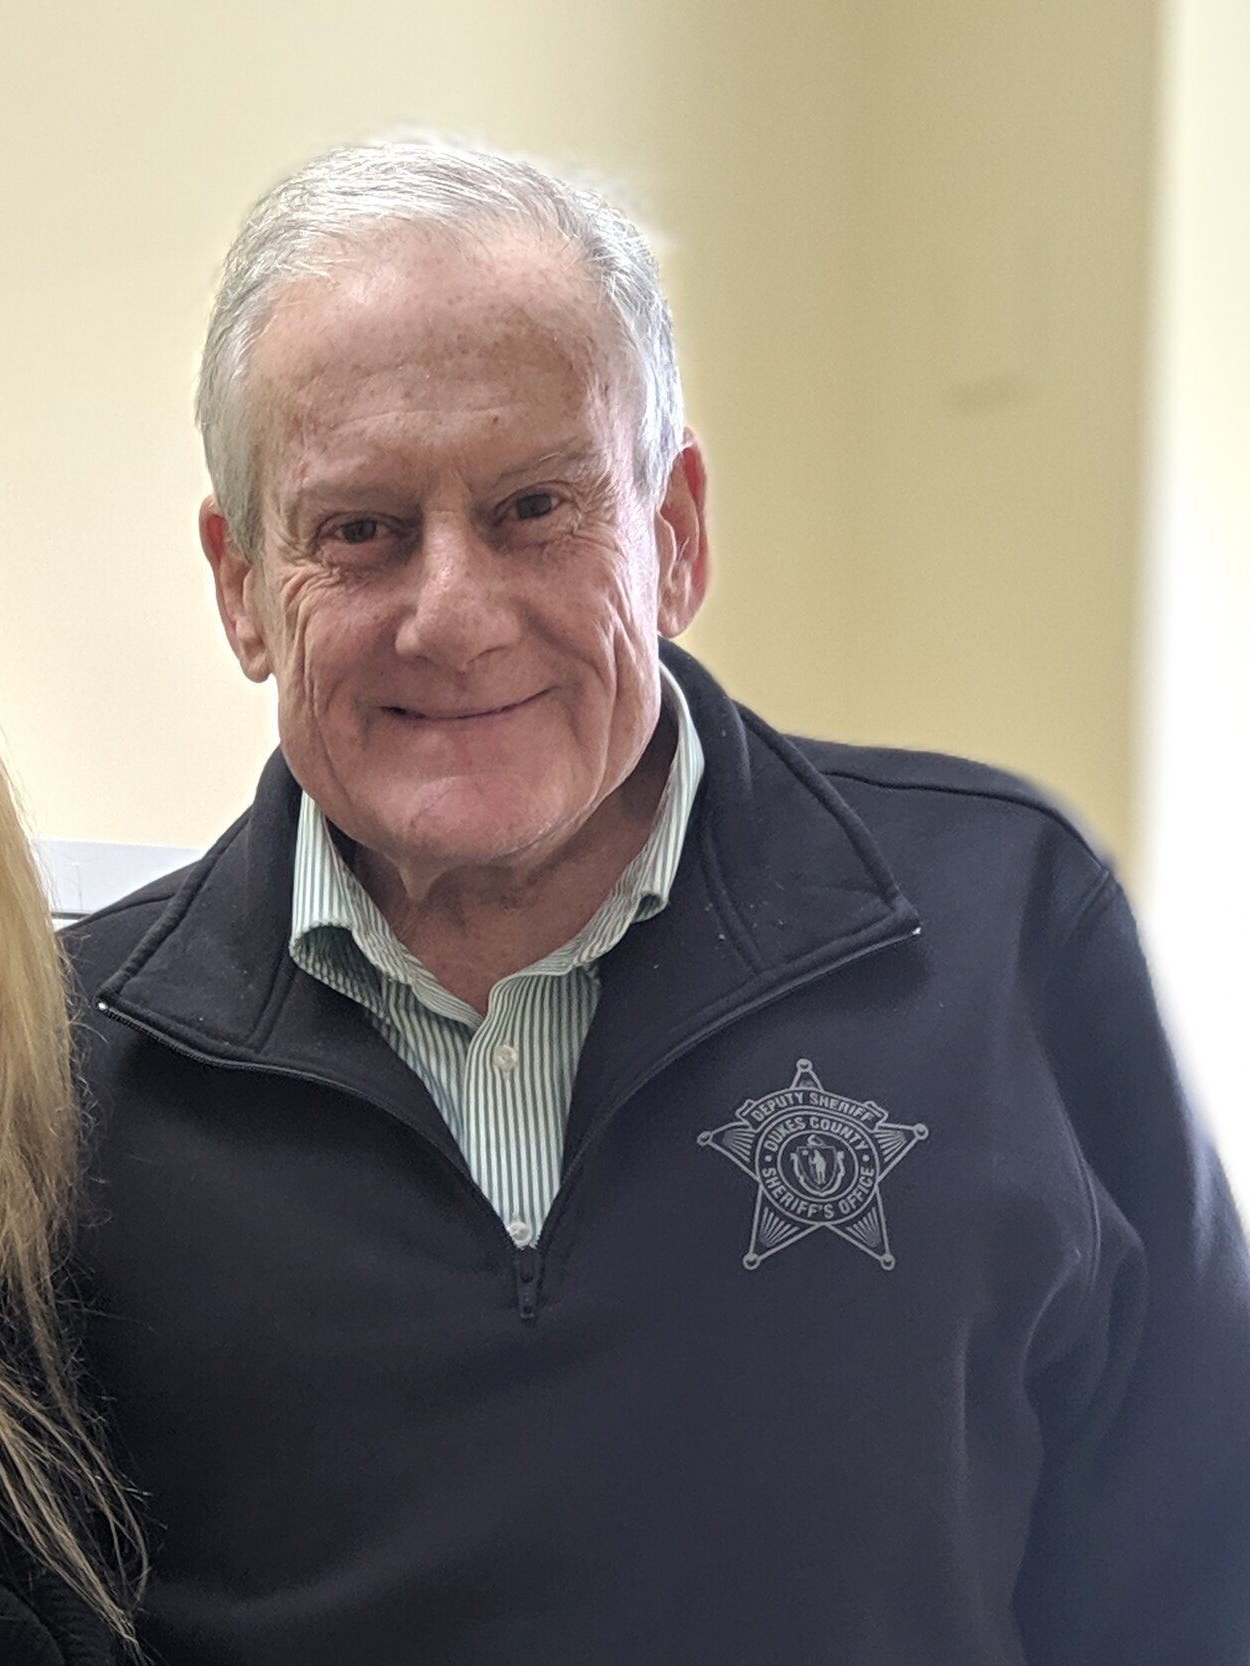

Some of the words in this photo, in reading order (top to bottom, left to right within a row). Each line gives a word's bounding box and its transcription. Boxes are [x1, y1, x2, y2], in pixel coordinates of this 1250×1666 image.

[750, 1091, 804, 1122] DEPUTY
[809, 1092, 875, 1123] SHERIFF
[764, 1116, 806, 1152] DUKES
[809, 1115, 869, 1151] COUNTY
[762, 1166, 835, 1219] SHERIFF'S
[838, 1166, 875, 1216] OFFICE
